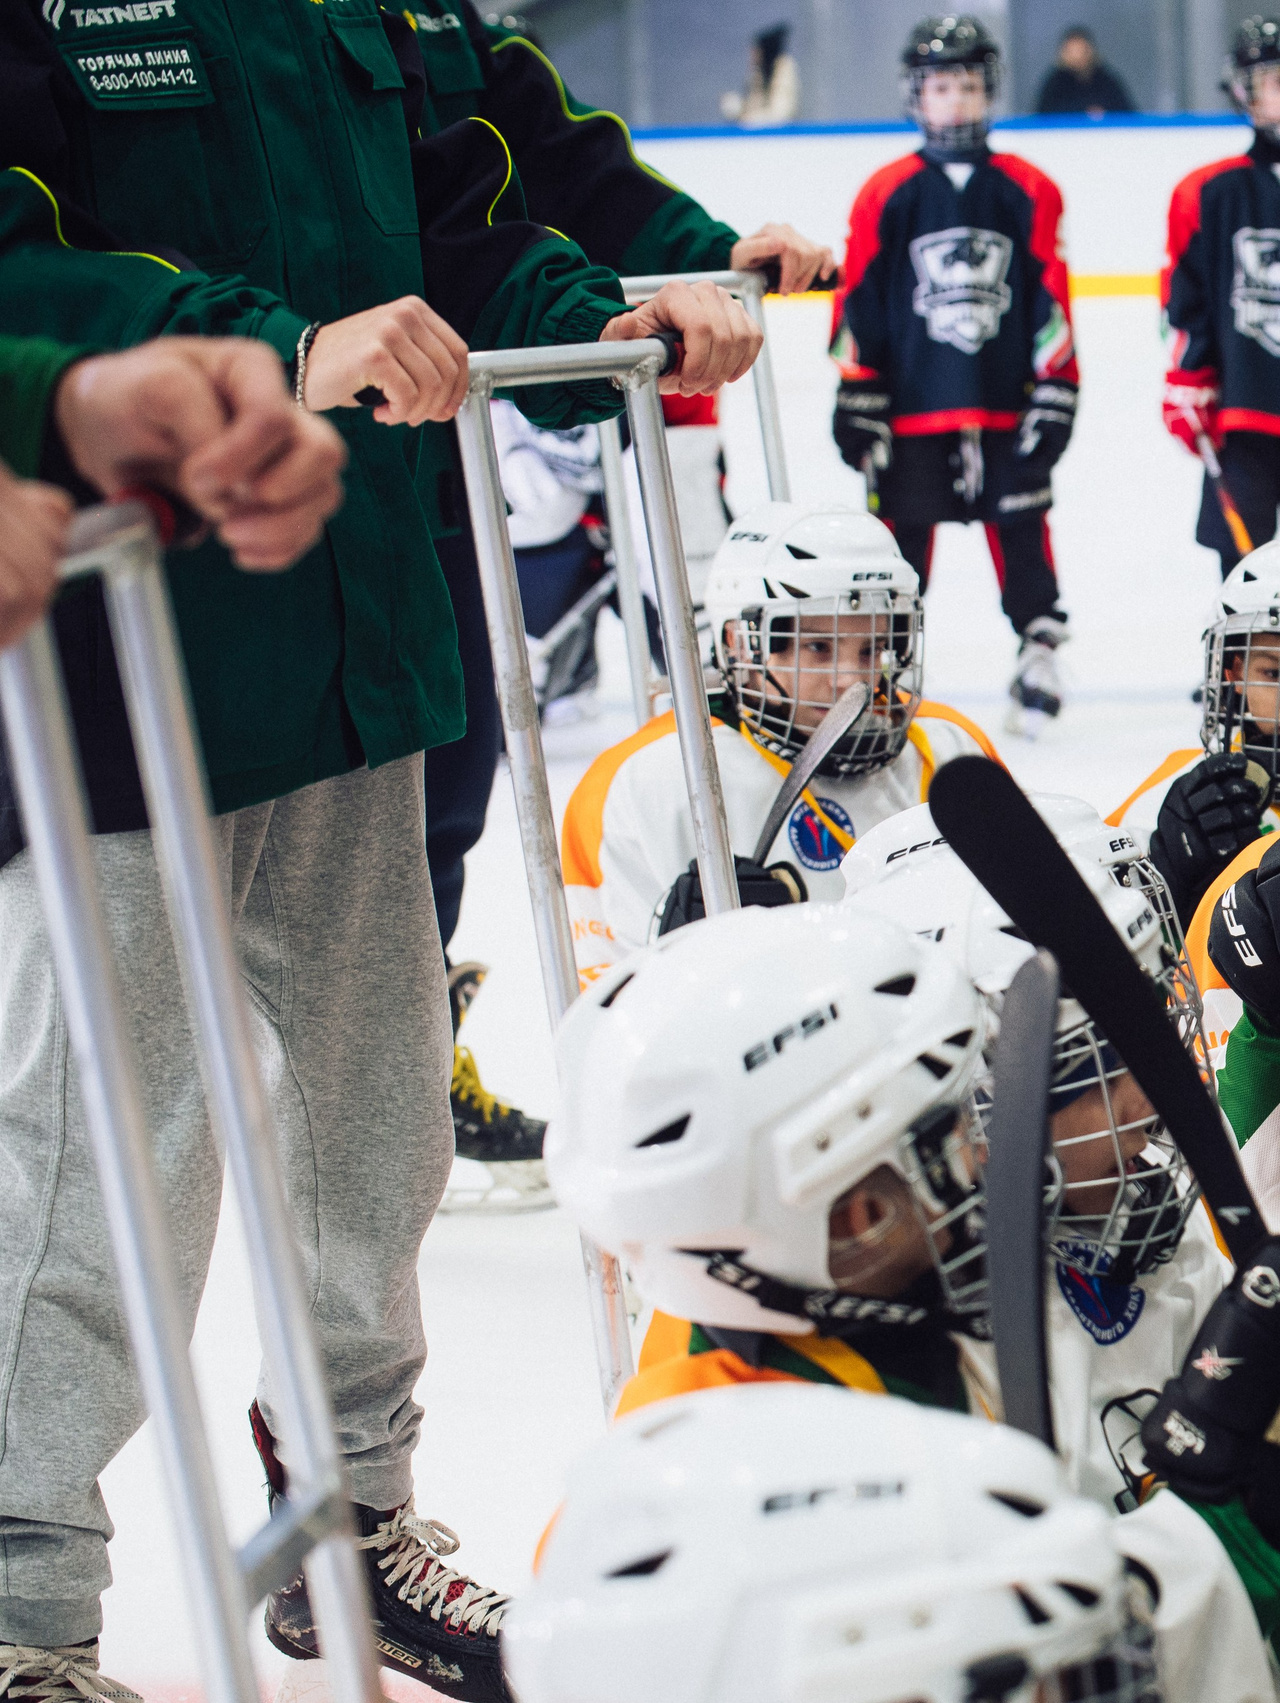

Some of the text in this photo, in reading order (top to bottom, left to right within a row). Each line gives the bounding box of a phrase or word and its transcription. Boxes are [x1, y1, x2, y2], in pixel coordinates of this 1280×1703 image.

[70, 0, 176, 28] TATNEFT
[77, 49, 191, 72] ГОРЯЧАЯ ЛИНИЯ
[89, 68, 197, 91] 8-800-100-41-12
[731, 532, 768, 542] EFSI
[852, 572, 893, 581] EFSI
[1109, 837, 1135, 853] EFS
[1222, 884, 1263, 967] EFS
[744, 1002, 838, 1072] EFSI
[380, 1643, 419, 1666] UER
